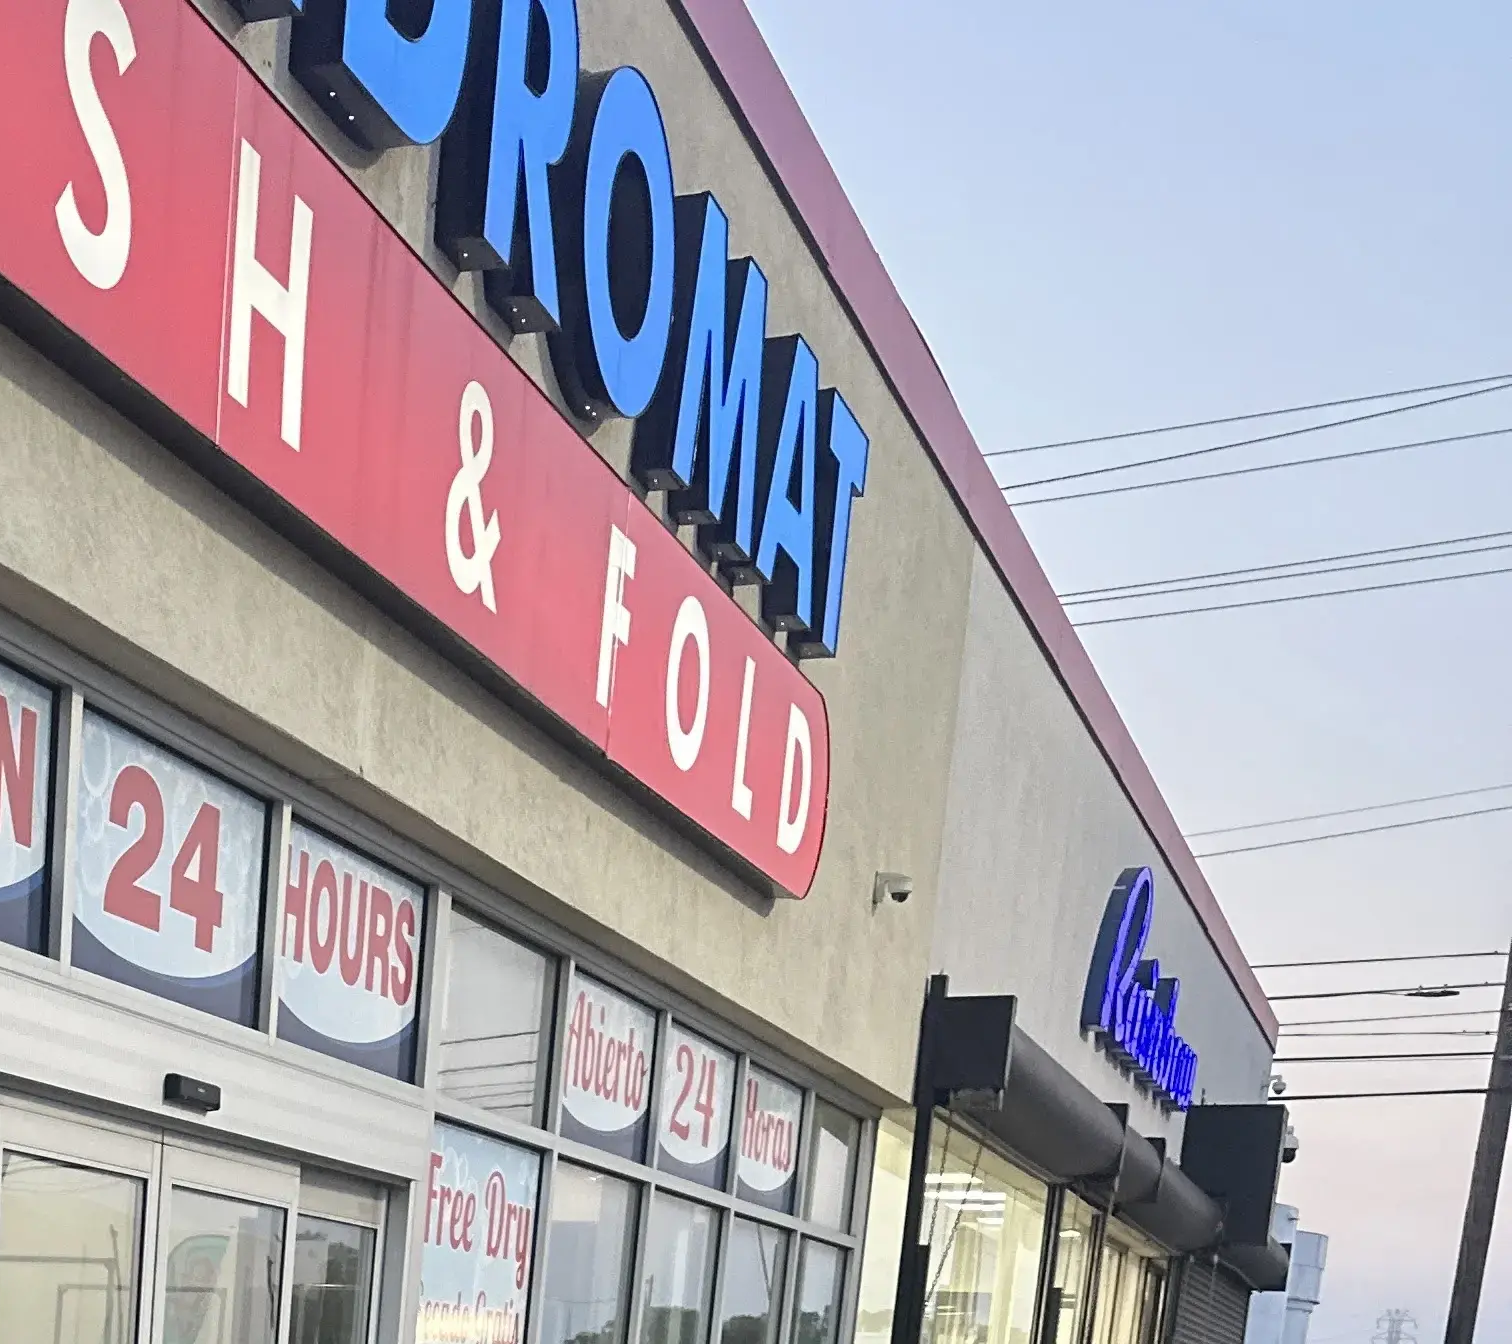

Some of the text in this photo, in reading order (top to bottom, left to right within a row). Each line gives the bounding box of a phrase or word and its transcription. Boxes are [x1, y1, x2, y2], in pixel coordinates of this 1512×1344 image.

[443, 379, 503, 615] &
[595, 522, 814, 856] FOLD
[102, 764, 225, 955] 24
[281, 843, 416, 1007] HOURS
[564, 990, 793, 1173] Abierto 24 Horas
[424, 1152, 531, 1290] Free Dry
